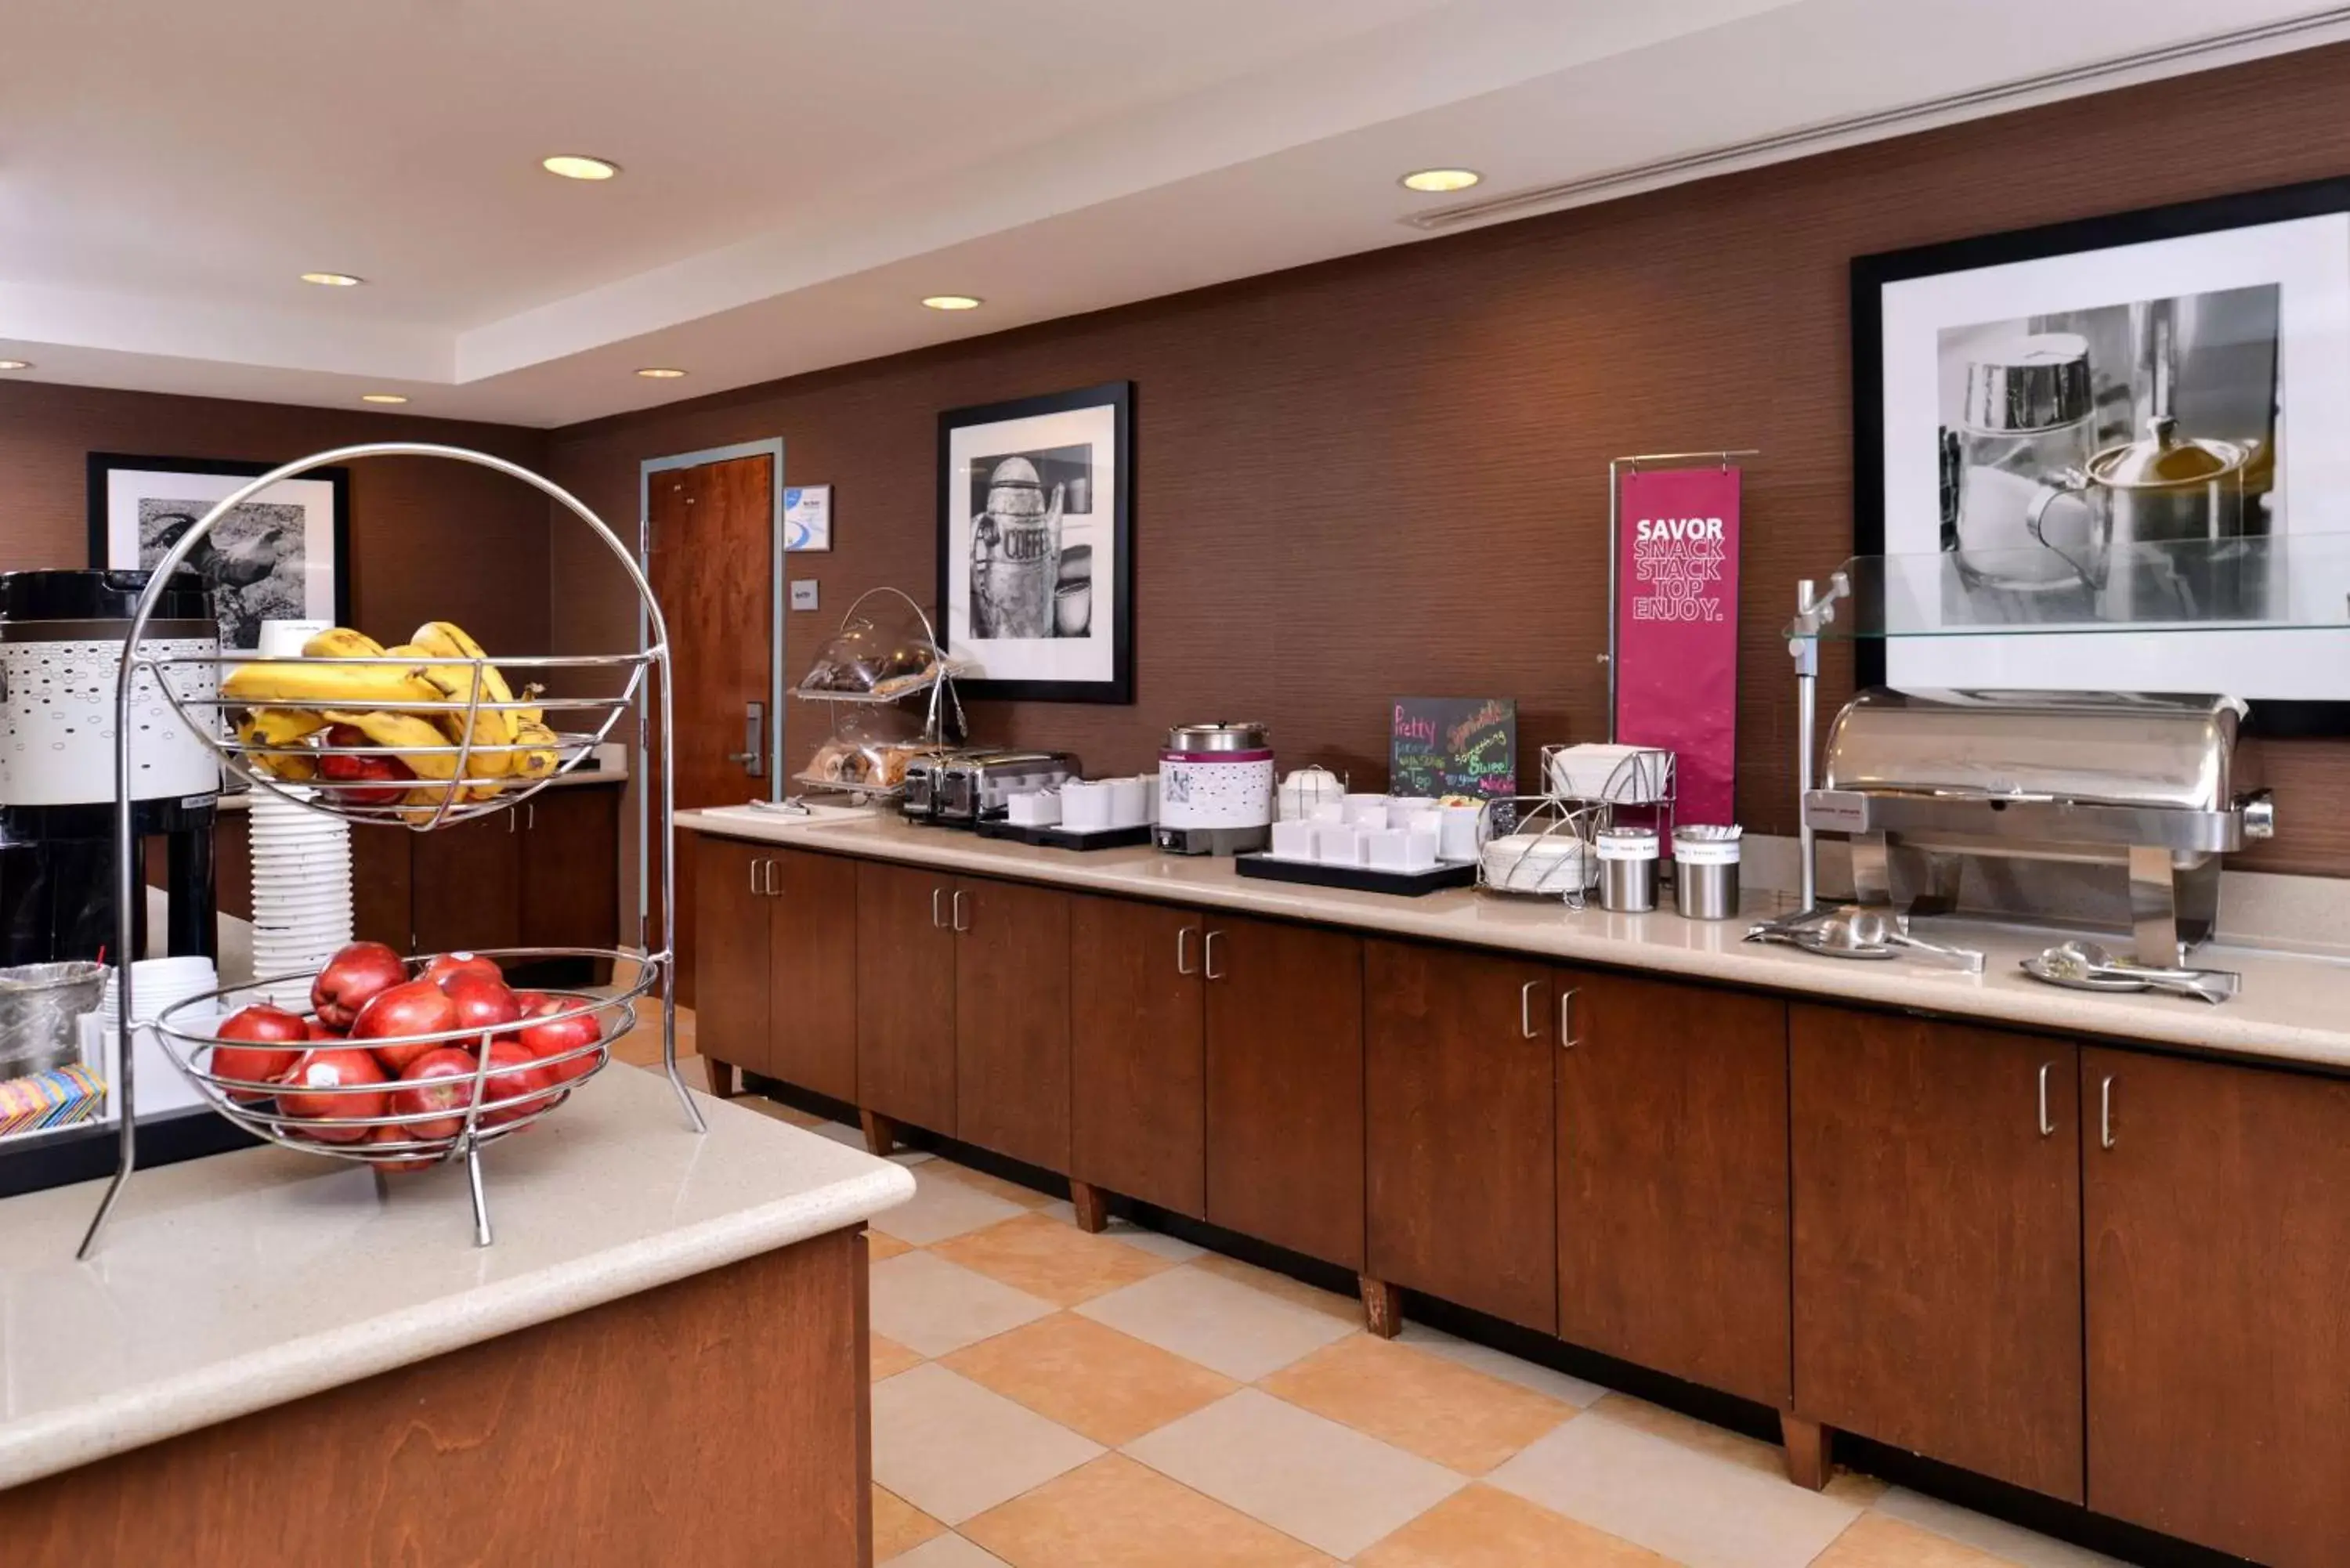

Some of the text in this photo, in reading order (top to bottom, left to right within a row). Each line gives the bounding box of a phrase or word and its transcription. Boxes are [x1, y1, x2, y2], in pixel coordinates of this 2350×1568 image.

[1636, 518, 1723, 540] SAVOR
[1634, 538, 1725, 559] SNACK
[1636, 558, 1722, 580] STACK
[1653, 579, 1704, 599] TOP
[1633, 598, 1723, 620] ENJOY.
[1394, 703, 1436, 747] Pretty
